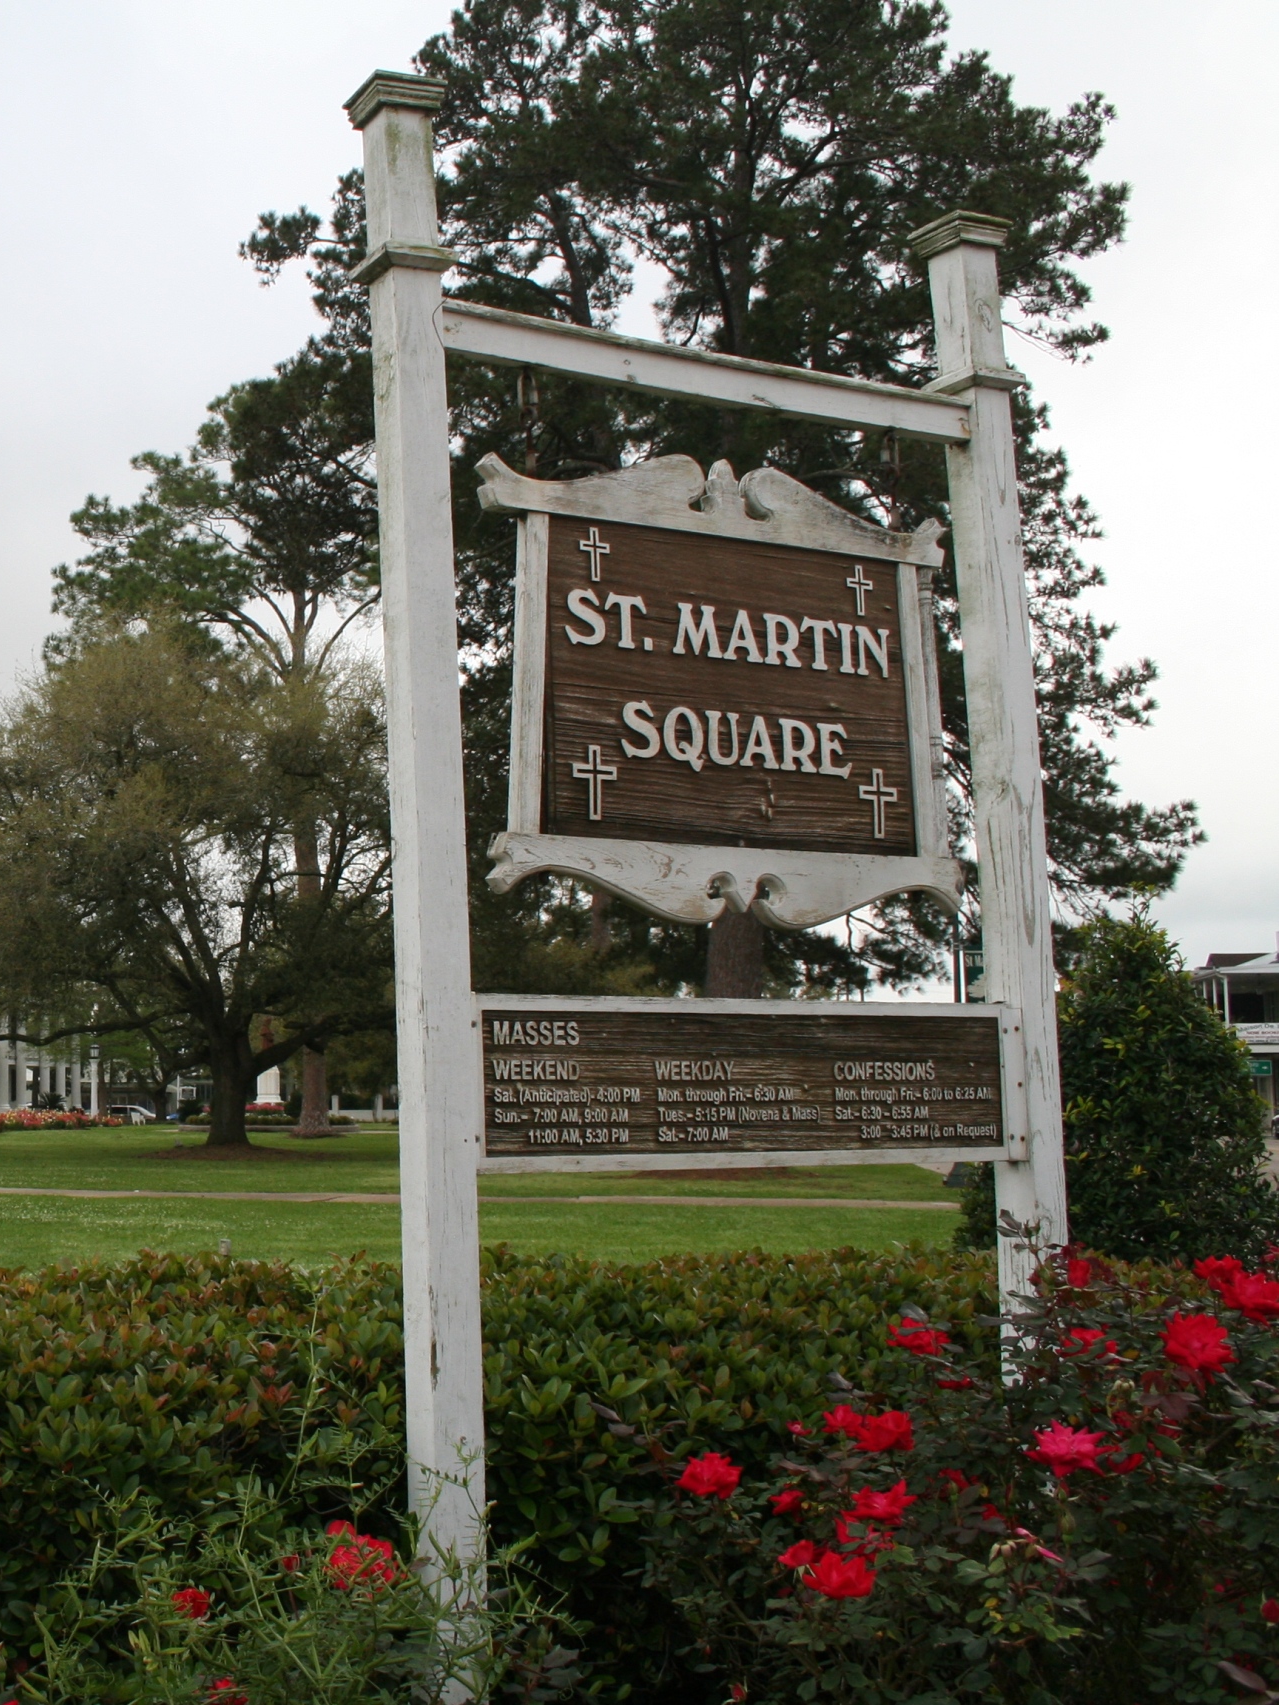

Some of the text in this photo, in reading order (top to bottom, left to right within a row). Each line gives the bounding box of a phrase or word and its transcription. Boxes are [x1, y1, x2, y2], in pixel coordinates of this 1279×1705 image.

[565, 588, 889, 678] ST. MARTIN
[621, 701, 852, 780] SQUARE
[493, 1021, 580, 1045] MASSES
[493, 1059, 580, 1080] WEEKEND
[655, 1061, 734, 1080] WEEKDAY
[834, 1061, 935, 1080] CONFESSIONS
[494, 1088, 516, 1102] Sat.
[597, 1088, 620, 1102] 4:00
[623, 1088, 640, 1102] PM
[658, 1088, 683, 1101] Mon.
[686, 1087, 726, 1104] through
[754, 1087, 775, 1101] 6:30
[778, 1087, 794, 1100] AM
[835, 1087, 858, 1101] Mon.
[861, 1087, 898, 1103] through
[923, 1088, 942, 1100] 6:00
[944, 1088, 953, 1099] to
[955, 1087, 975, 1099] 6:25
[976, 1087, 991, 1100] AM
[533, 1109, 556, 1122] 7:00
[560, 1109, 581, 1124] AM,
[585, 1109, 607, 1122] 9:00
[611, 1109, 628, 1122] AM
[695, 1107, 717, 1121] 5:15
[719, 1107, 735, 1121] PM
[738, 1107, 779, 1123] (Novena
[782, 1107, 789, 1120] &
[792, 1105, 820, 1122] Mass)
[861, 1106, 881, 1119] 6:30
[892, 1106, 912, 1119] 6:55
[914, 1106, 929, 1119] AM
[529, 1129, 629, 1145] 11:00 AM, 5:30 PM
[687, 1127, 709, 1141] 7:00
[711, 1127, 729, 1140] AM
[861, 1123, 997, 1139] 3:00 3:45 PM (& on Request)
